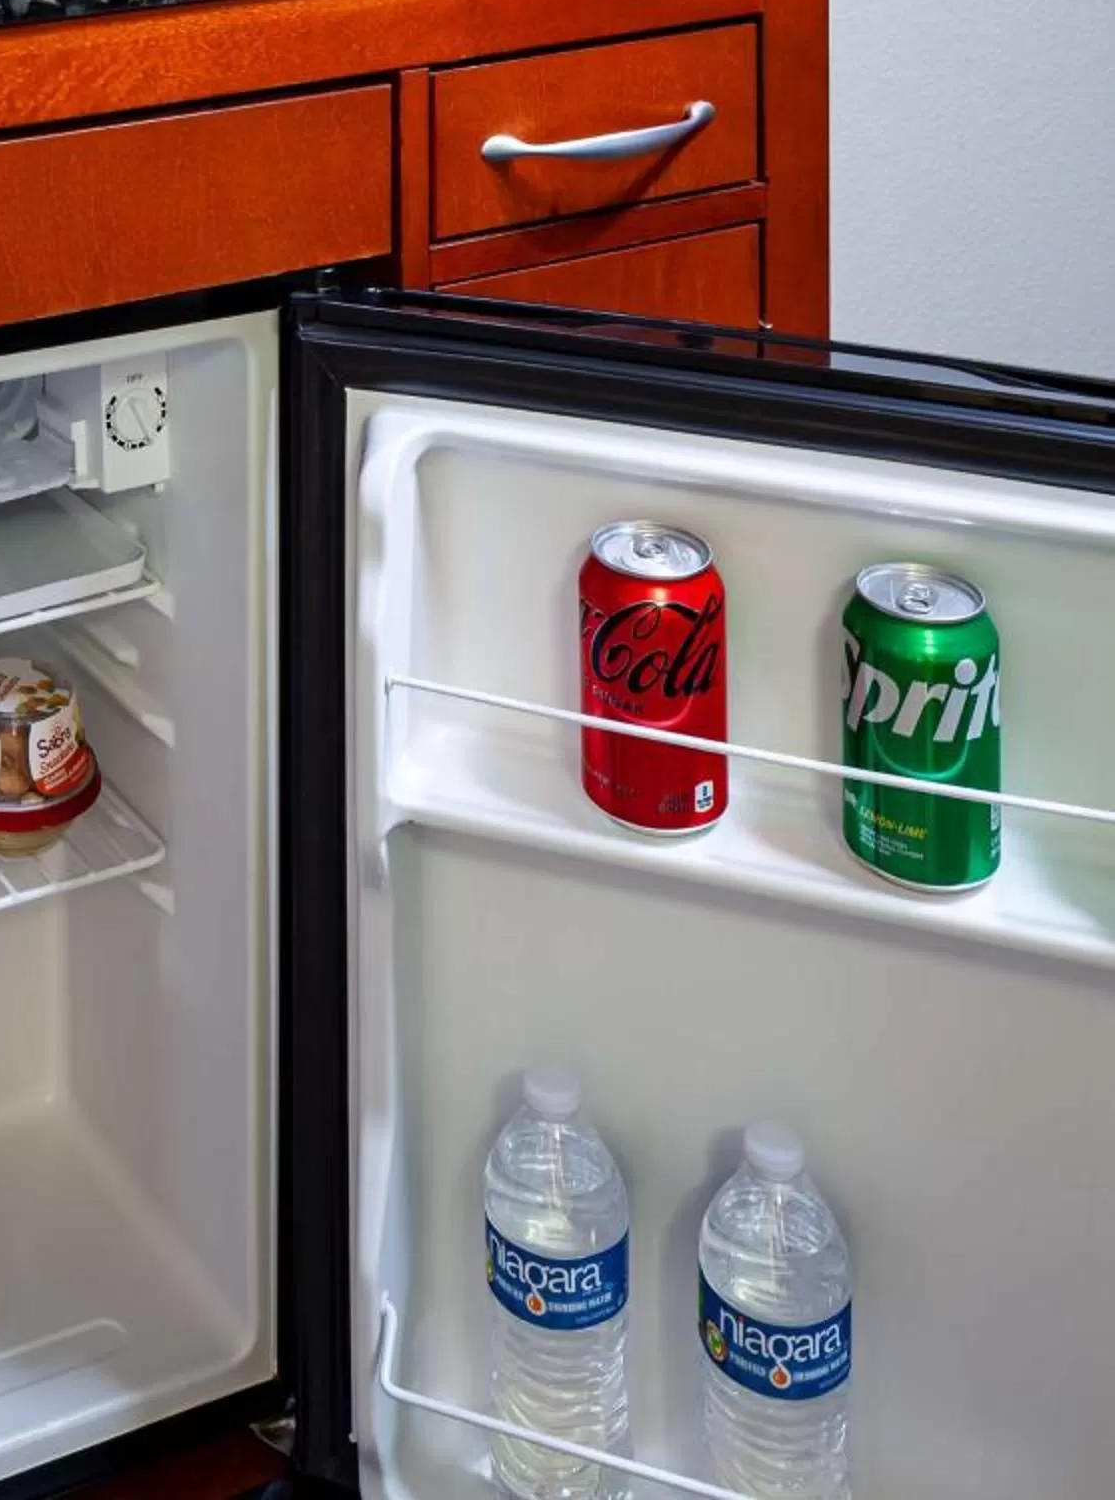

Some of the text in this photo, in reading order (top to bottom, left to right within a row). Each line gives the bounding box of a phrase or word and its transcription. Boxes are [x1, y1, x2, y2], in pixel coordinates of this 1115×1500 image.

[591, 592, 722, 698] Cola
[840, 627, 1000, 743] Sprit
[489, 1231, 602, 1299] niagara
[720, 1306, 842, 1363] niagara
